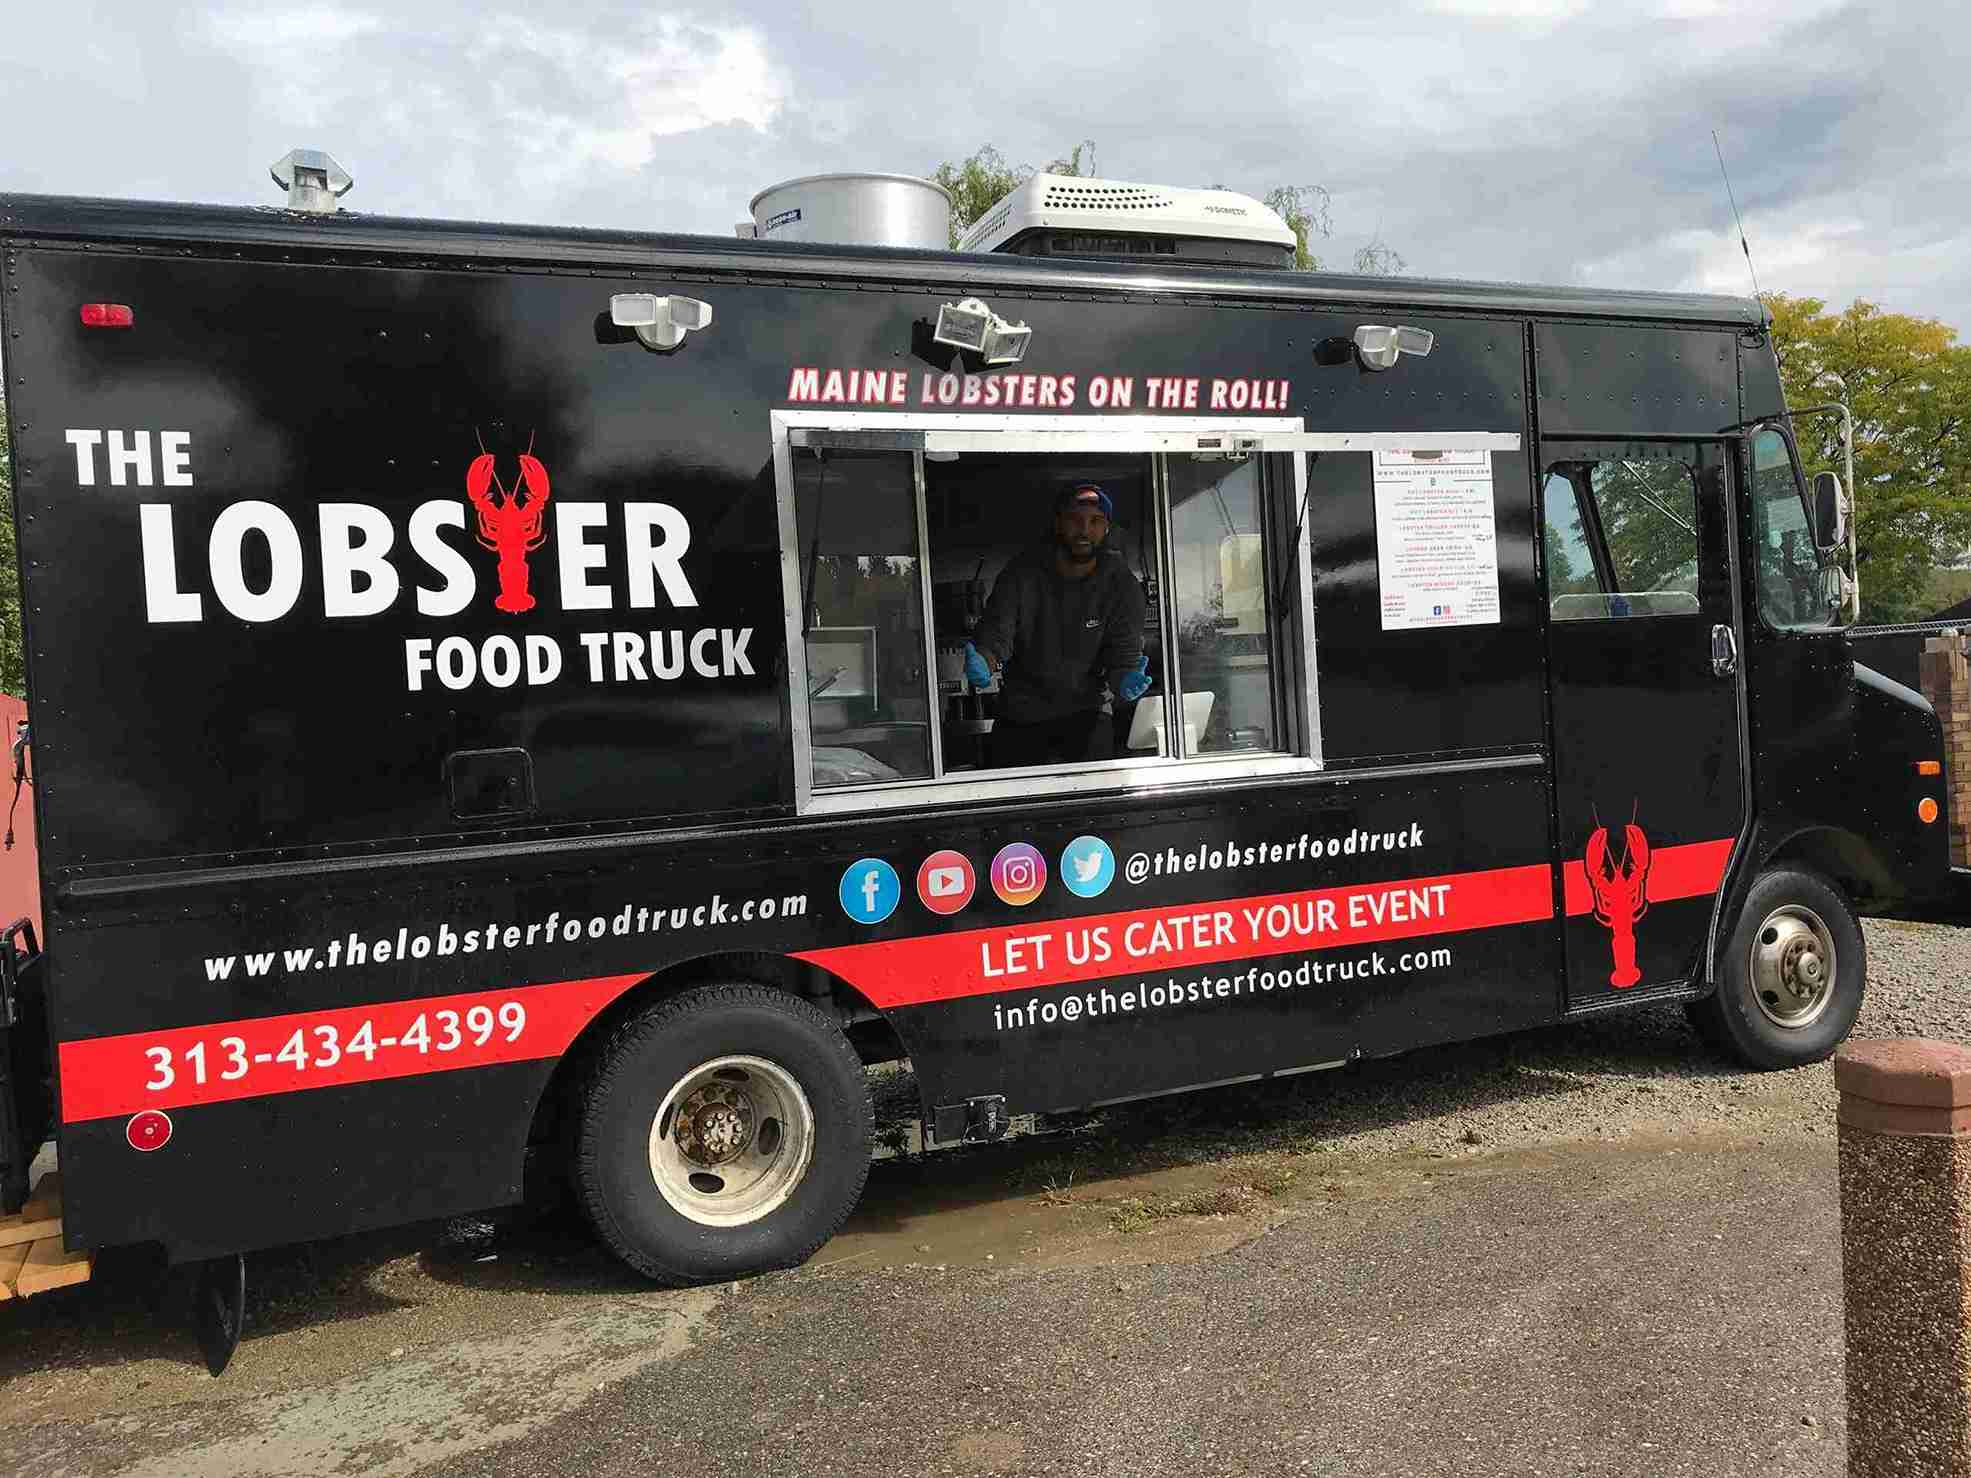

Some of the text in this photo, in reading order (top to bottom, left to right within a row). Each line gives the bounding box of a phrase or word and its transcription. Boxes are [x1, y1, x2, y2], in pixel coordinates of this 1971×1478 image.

[786, 367, 1290, 411] MAINE LOBSTERS ON THE ROLL!
[65, 428, 194, 487] THE
[405, 627, 756, 691] FOOD TRUCK
[1124, 822, 1425, 885] @thelobsterfoodtruck
[204, 894, 808, 981] www.thelobsterfoodtruck.com
[981, 884, 1452, 978] LET US CATER YOUR EVENT
[994, 948, 1452, 1030] info@thelobsterfoodtruck.com
[145, 1001, 526, 1091] 313-434-4399
